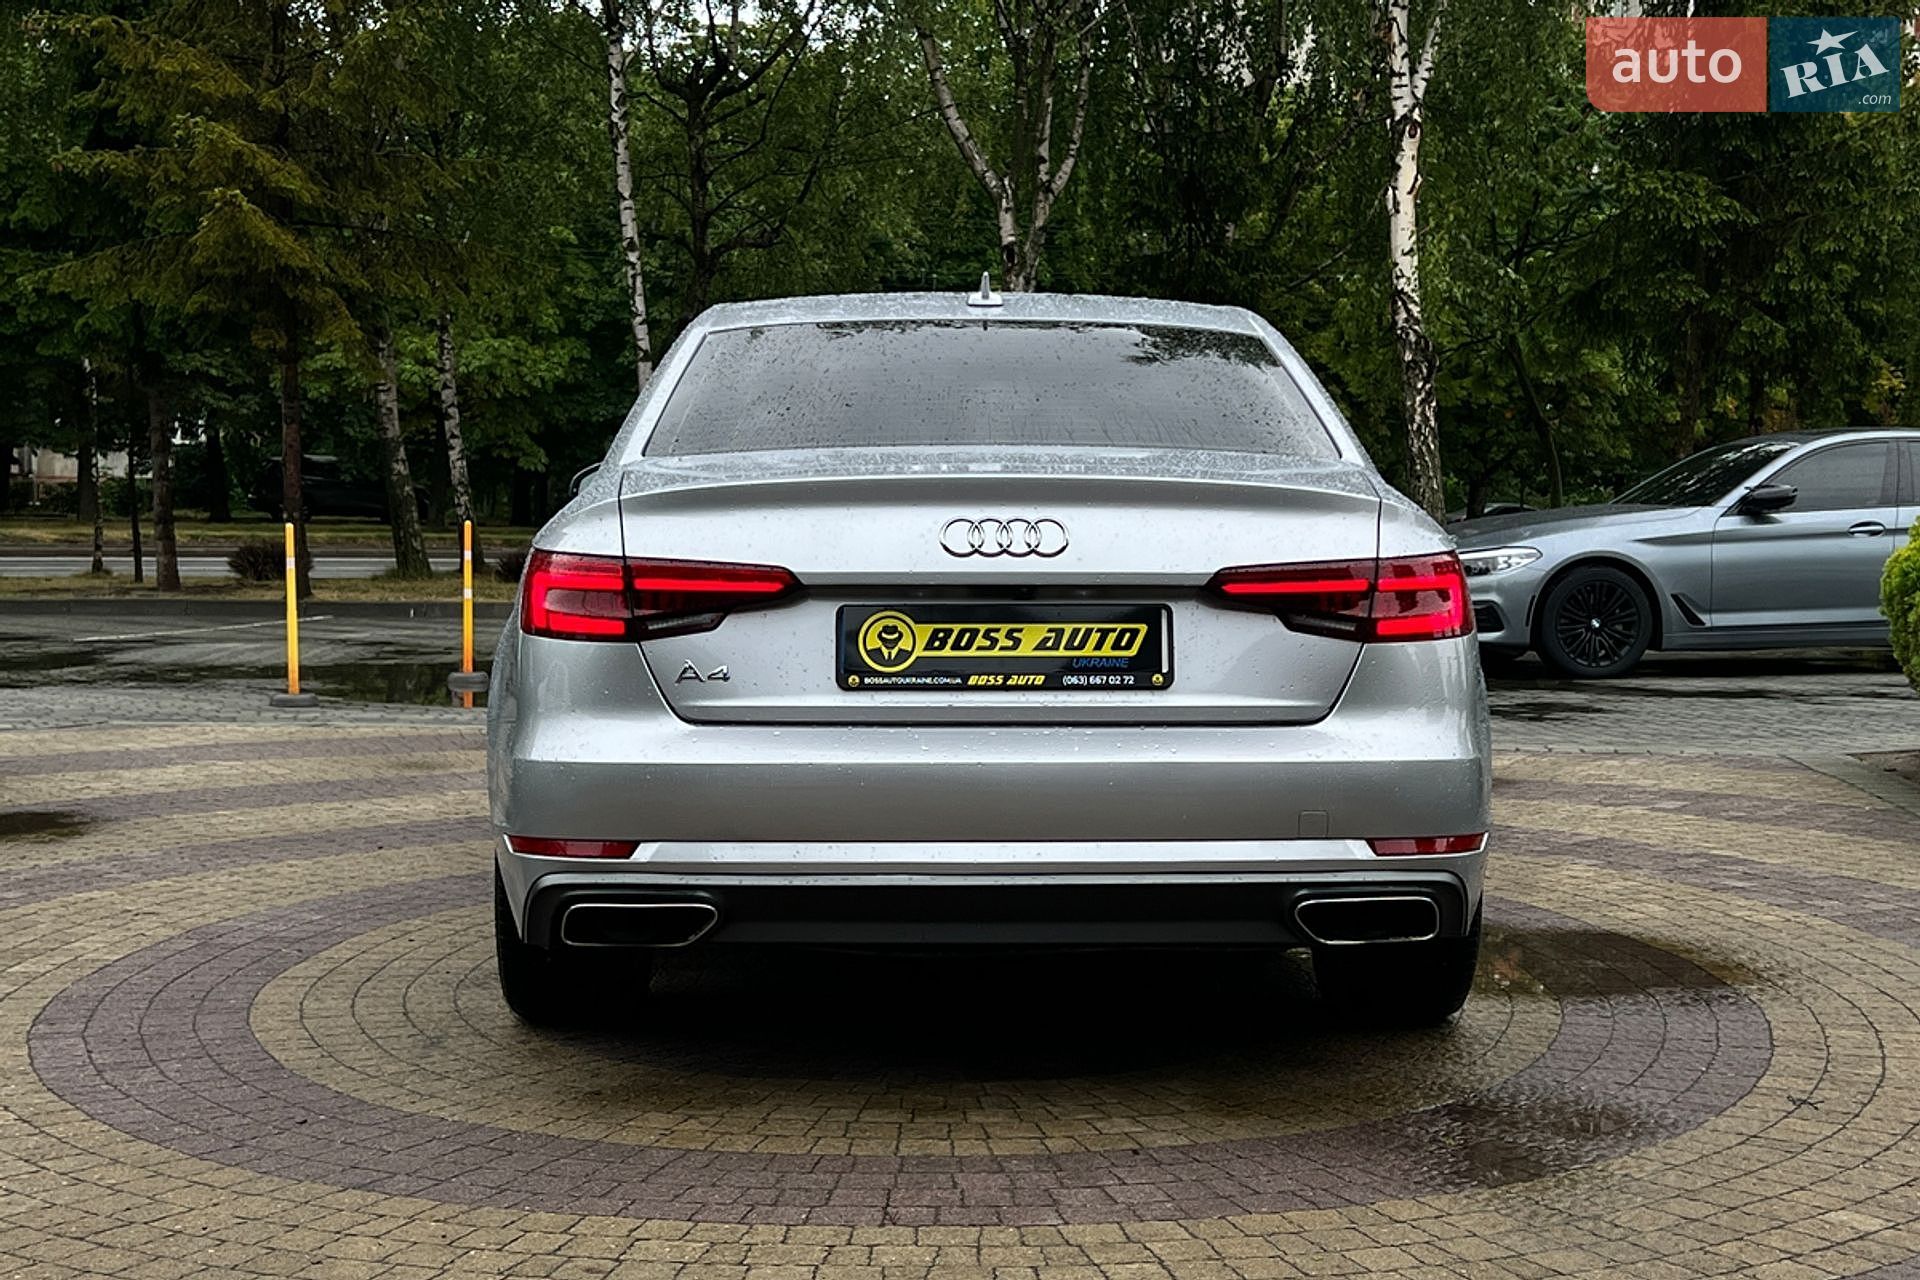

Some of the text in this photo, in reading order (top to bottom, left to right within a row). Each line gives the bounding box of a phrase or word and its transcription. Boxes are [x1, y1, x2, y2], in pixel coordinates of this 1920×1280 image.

[924, 627, 1139, 651] BOSS AUTO
[1072, 657, 1129, 668] UKRAINE
[674, 659, 730, 684] A4
[967, 675, 1045, 686] BOSS AUTO
[1062, 675, 1135, 686] (063) 667 02 72
